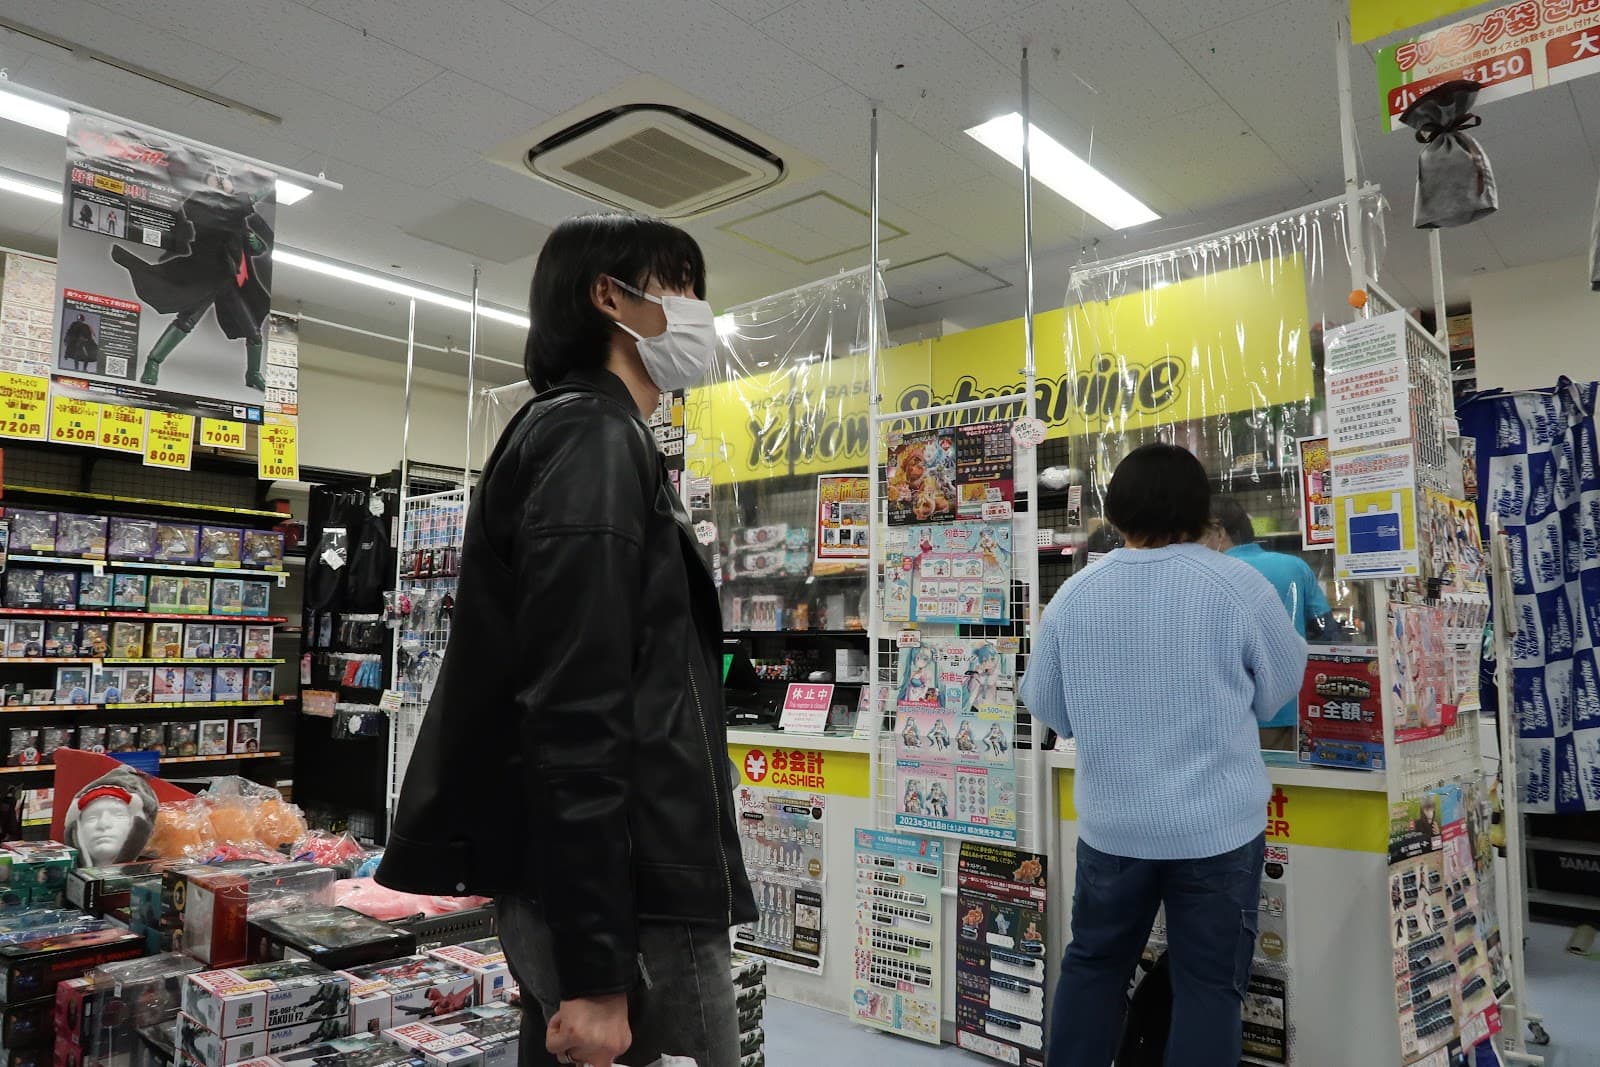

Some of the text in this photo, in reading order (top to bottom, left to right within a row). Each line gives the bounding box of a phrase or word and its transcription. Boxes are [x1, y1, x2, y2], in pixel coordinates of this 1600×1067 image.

[1394, 88, 1417, 111] 小
[747, 353, 1186, 468] Yellow Submarine
[0, 420, 41, 434] 720円
[56, 427, 96, 441] 650円
[103, 432, 139, 448] 850円
[206, 431, 240, 444] 700円
[1534, 414, 1549, 445] Yellow
[150, 450, 185, 464] 800円
[263, 465, 295, 476] 1800円
[1497, 488, 1510, 518] Yellow
[1510, 464, 1523, 516] Submarine
[1583, 527, 1595, 560] Yellow
[1540, 551, 1553, 583] Yellow
[1522, 604, 1538, 656] Submarine
[1557, 597, 1571, 648] Submarine
[792, 687, 828, 700] 休止中
[1532, 676, 1547, 727] Submarine
[1581, 660, 1600, 715] Submarine
[1323, 701, 1362, 721] 全額
[1522, 700, 1535, 731] Yellow
[1575, 688, 1589, 721] Yellow
[771, 749, 825, 775] お会計
[1539, 748, 1551, 802] Submarine
[771, 771, 825, 789] CASHIER
[1527, 771, 1539, 804] Yellow
